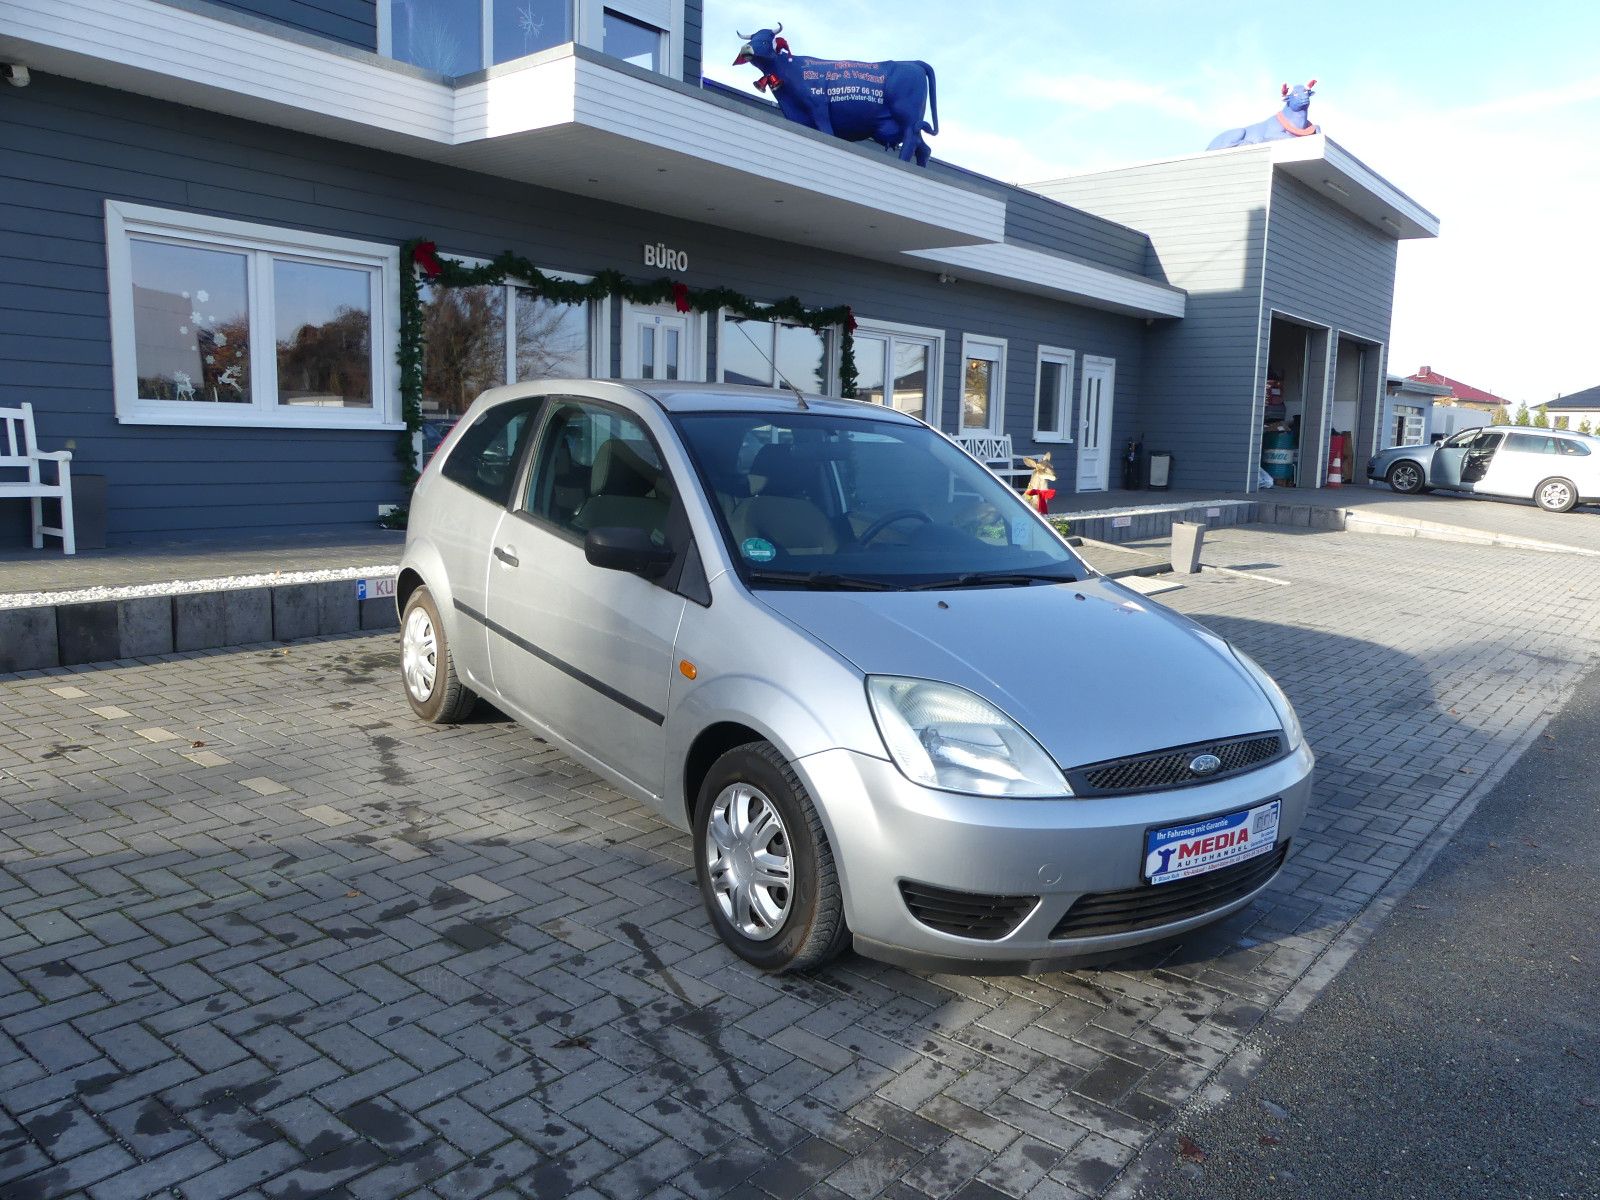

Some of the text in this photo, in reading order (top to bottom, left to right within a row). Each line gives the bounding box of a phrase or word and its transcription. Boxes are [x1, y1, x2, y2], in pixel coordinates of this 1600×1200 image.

[811, 87, 825, 95] Tel.
[827, 86, 860, 96] 0391/597
[644, 242, 688, 272] BÜRO
[376, 580, 396, 596] KU
[1157, 819, 1229, 840] Ihr Fahrzeug mit Garantie
[1178, 828, 1249, 859] MEDIA
[1177, 844, 1248, 868] AUTOHANDEL
